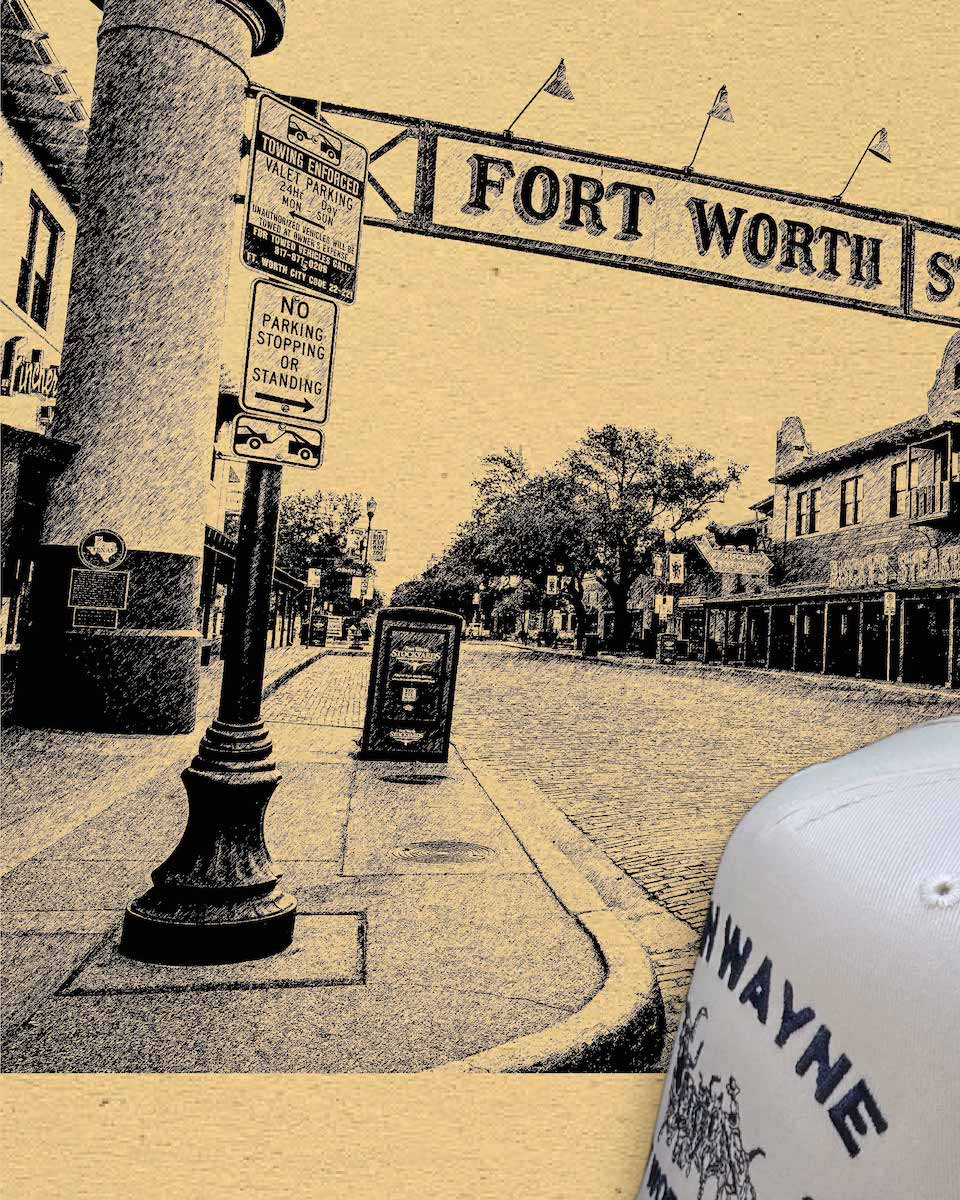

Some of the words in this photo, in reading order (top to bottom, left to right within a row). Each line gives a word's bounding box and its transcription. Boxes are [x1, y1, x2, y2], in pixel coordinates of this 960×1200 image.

[261, 134, 304, 169] TOWING
[307, 158, 360, 196] ENFORCED
[266, 157, 300, 185] VALET
[305, 177, 353, 211] PARKING
[281, 195, 302, 211] MON
[252, 203, 300, 231] UNAUTHORIZED
[302, 225, 330, 244] VEHICLES
[258, 217, 282, 233] TOWED
[283, 227, 291, 238] AT
[460, 153, 655, 241] FORT
[685, 197, 883, 290] WORTH
[252, 227, 268, 240] FOR
[271, 234, 296, 251] TOWED
[298, 245, 331, 266] VEHICLES
[261, 257, 288, 275] WORTH
[289, 267, 307, 281] CITY
[308, 275, 327, 290] CODE
[280, 295, 310, 319] NO
[262, 313, 324, 342] PARKING
[256, 330, 325, 360] STOPPING
[280, 355, 299, 372] OR
[252, 367, 322, 395] STANDING
[718, 913, 889, 1159] WAYNE
